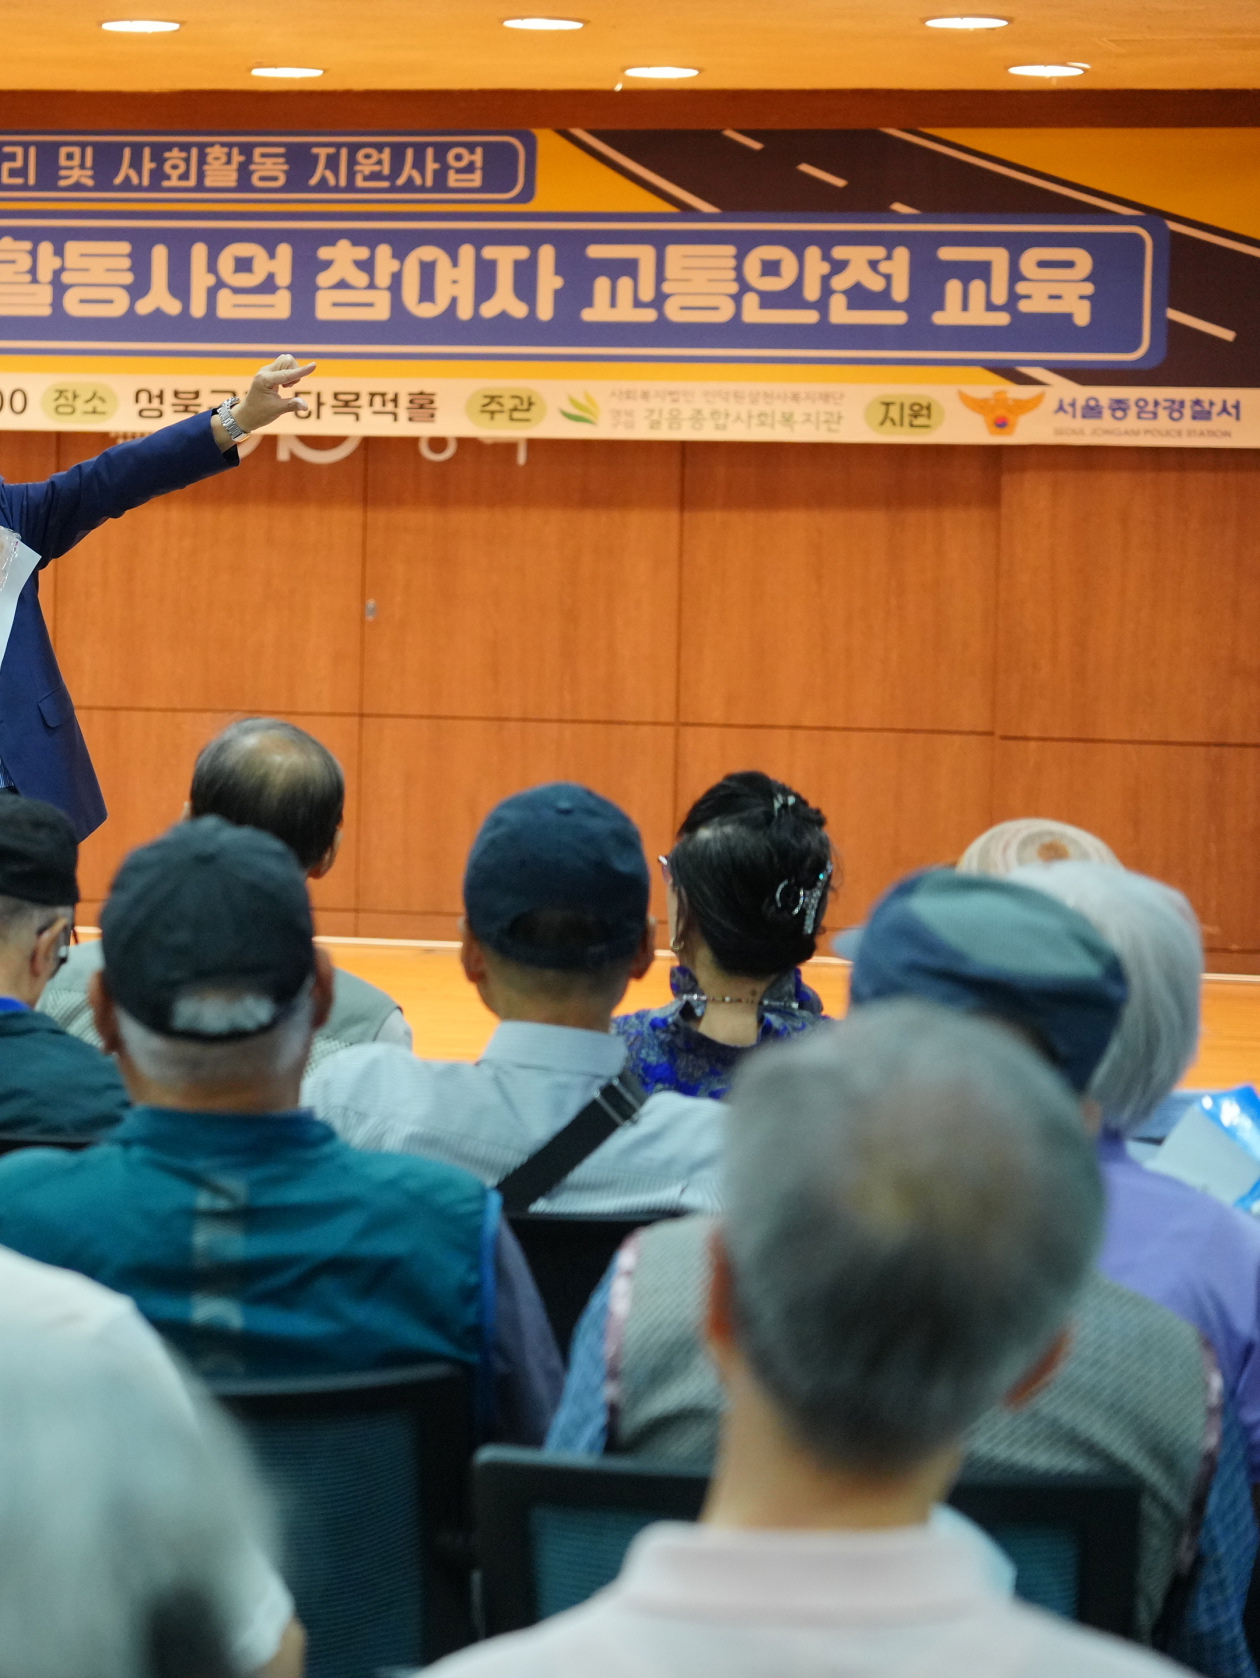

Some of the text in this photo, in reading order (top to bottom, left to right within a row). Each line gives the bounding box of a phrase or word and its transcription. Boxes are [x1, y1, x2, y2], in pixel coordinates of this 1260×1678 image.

[57, 145, 95, 188] 및
[112, 144, 289, 188] 사회활동
[308, 146, 484, 189] 지원사업
[314, 238, 565, 322] 참여자
[580, 244, 910, 325] 교통안전
[930, 246, 1095, 327] 교육
[53, 388, 107, 416] 장소
[293, 389, 437, 423] 다목적홀
[479, 394, 536, 423] 주관
[879, 400, 932, 429] 지원
[1054, 396, 1242, 422] 서울종암경찰서
[644, 407, 843, 433] 길음종합사회복지관
